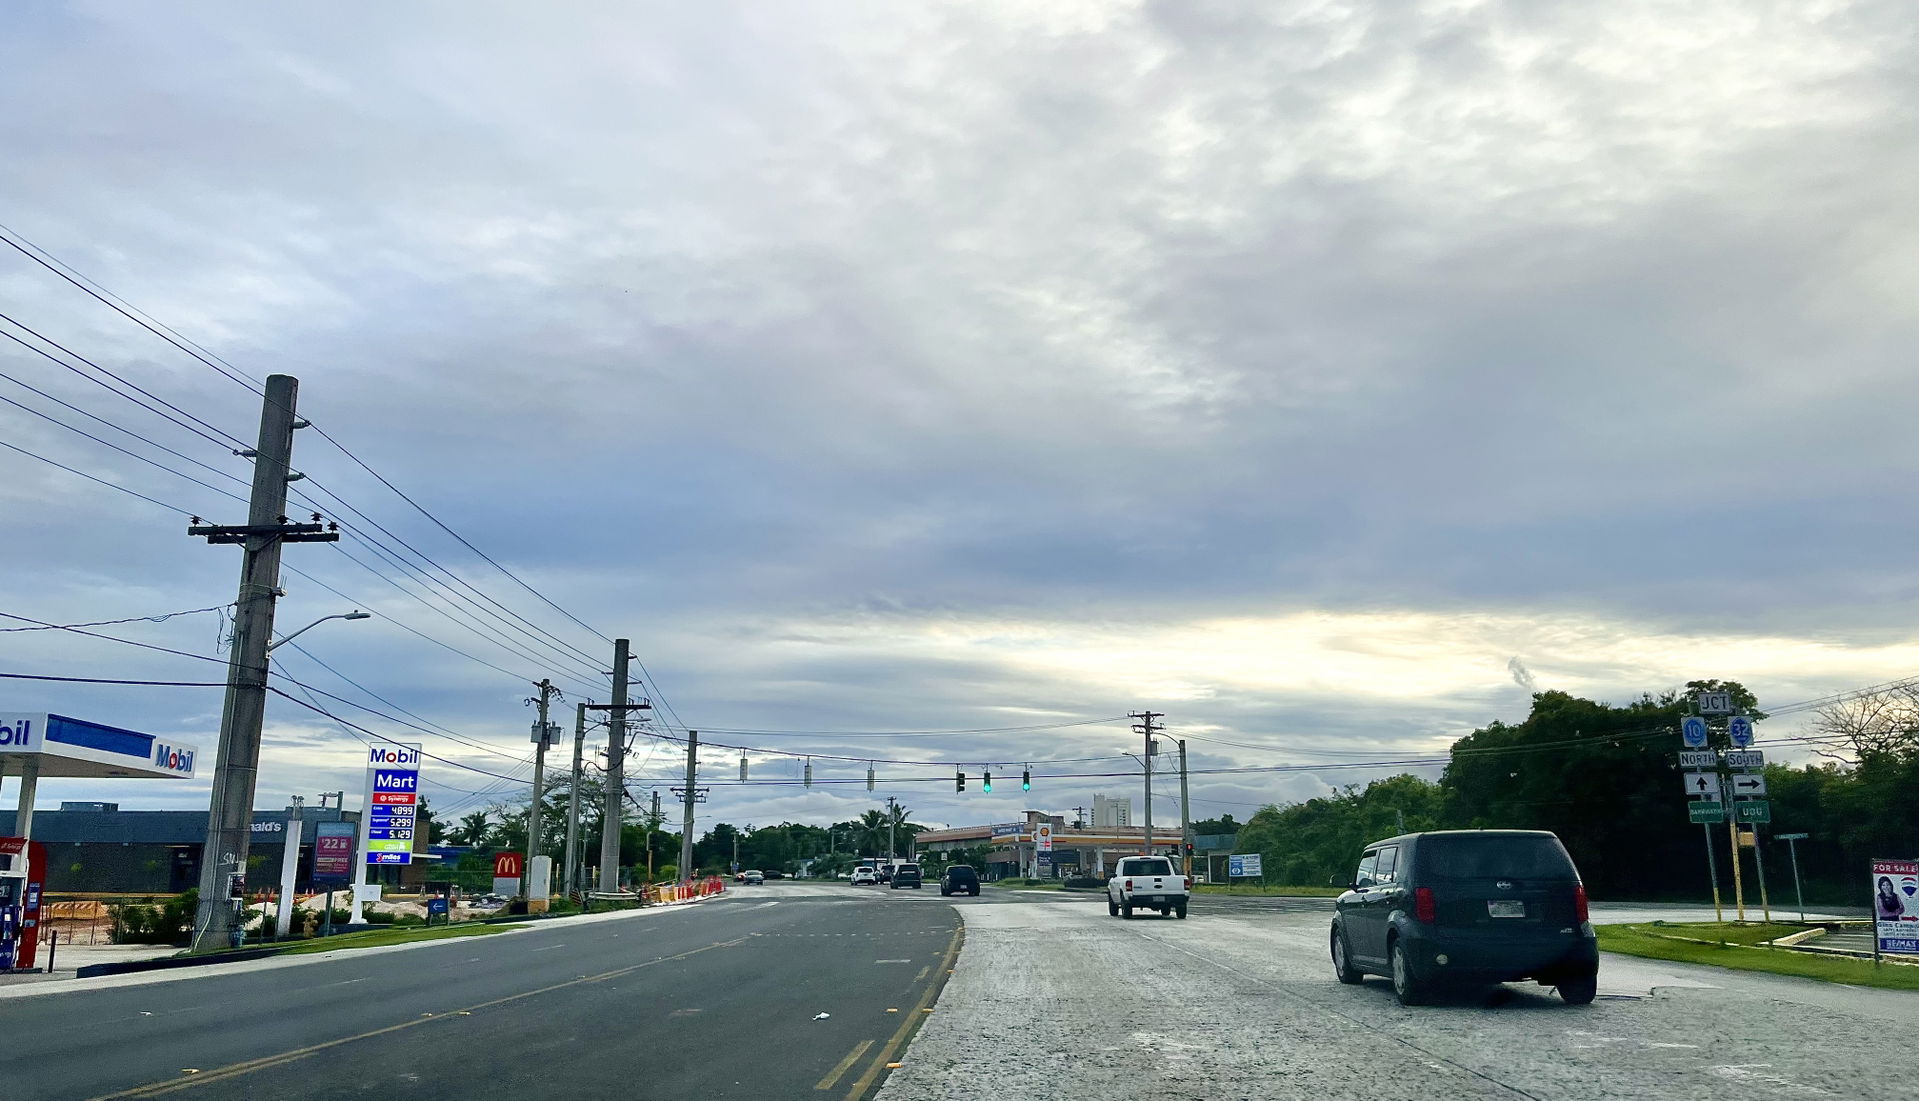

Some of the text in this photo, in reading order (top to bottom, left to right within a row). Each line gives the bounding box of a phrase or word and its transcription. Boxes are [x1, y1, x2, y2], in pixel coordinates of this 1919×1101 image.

[1702, 696, 1727, 709] JCT
[1688, 725, 1701, 737] 10
[1733, 723, 1749, 736] 32
[155, 744, 194, 772] Mobil
[370, 748, 418, 763] Mobil
[1681, 753, 1715, 765] NORTH
[1729, 754, 1762, 765] SOUTH
[377, 774, 414, 788] Mart
[1873, 864, 1916, 873] FOR SALE
